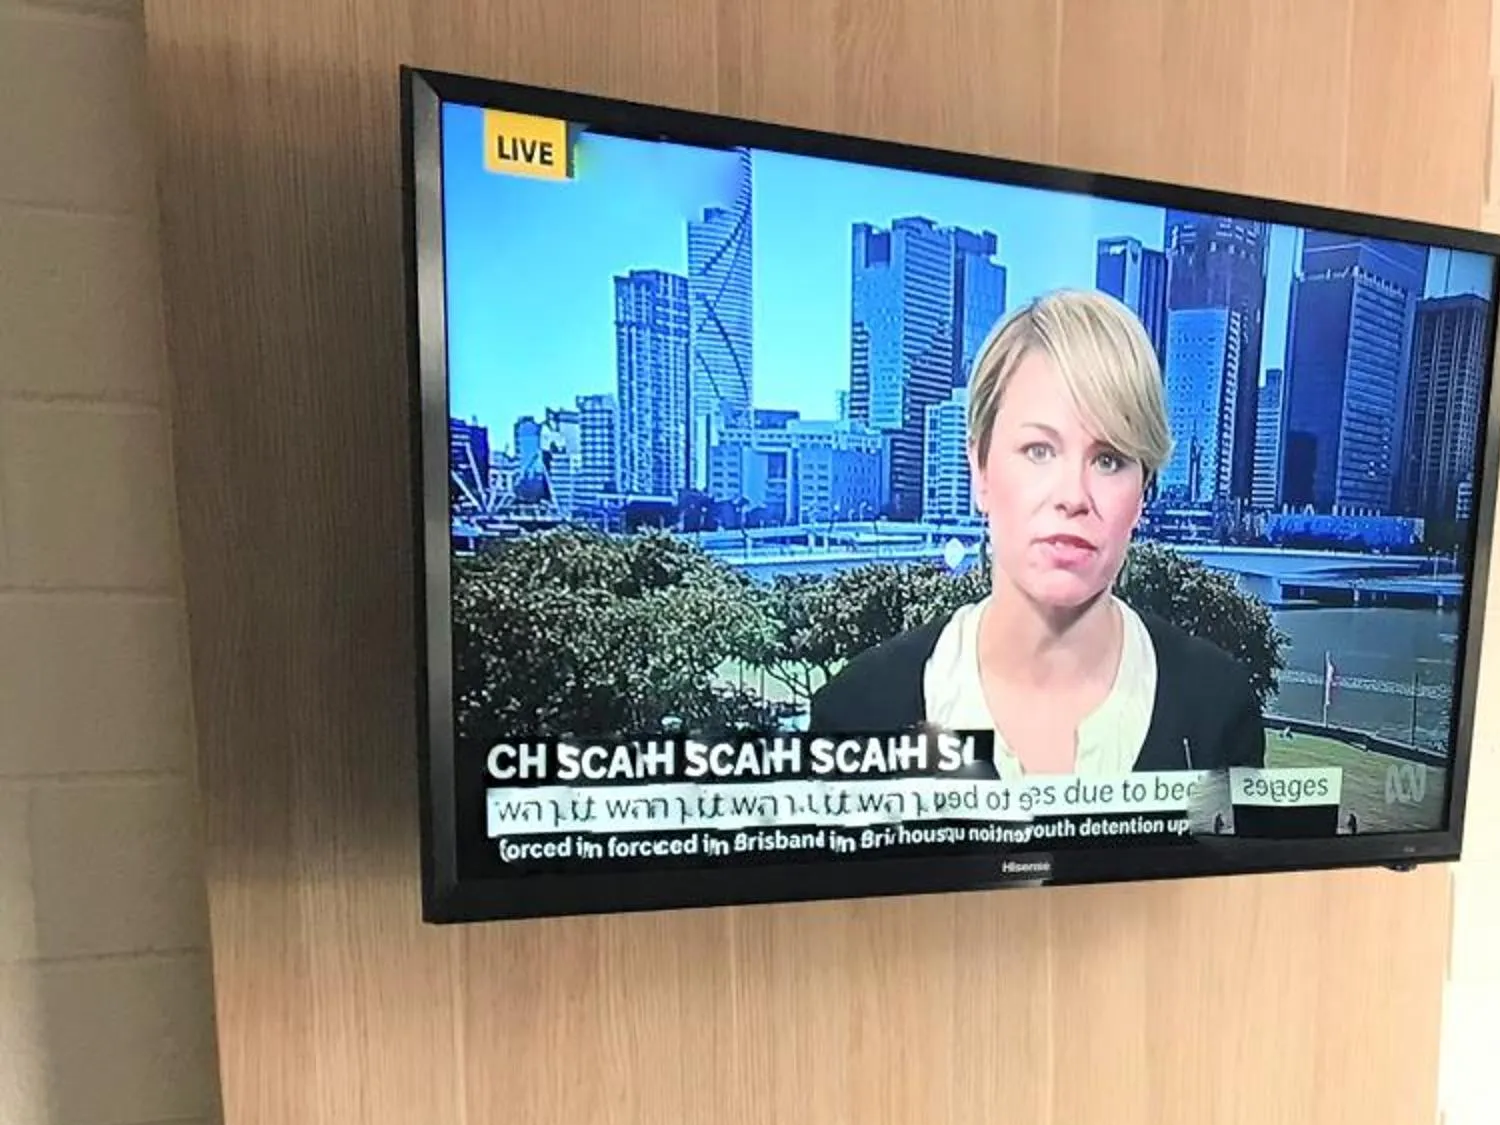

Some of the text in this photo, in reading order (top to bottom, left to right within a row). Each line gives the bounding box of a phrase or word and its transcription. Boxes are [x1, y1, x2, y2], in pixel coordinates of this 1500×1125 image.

[497, 135, 554, 166] LIVE
[487, 743, 547, 779] CH
[1064, 778, 1113, 804] due
[1122, 779, 1147, 802] to
[1079, 815, 1164, 836] detention
